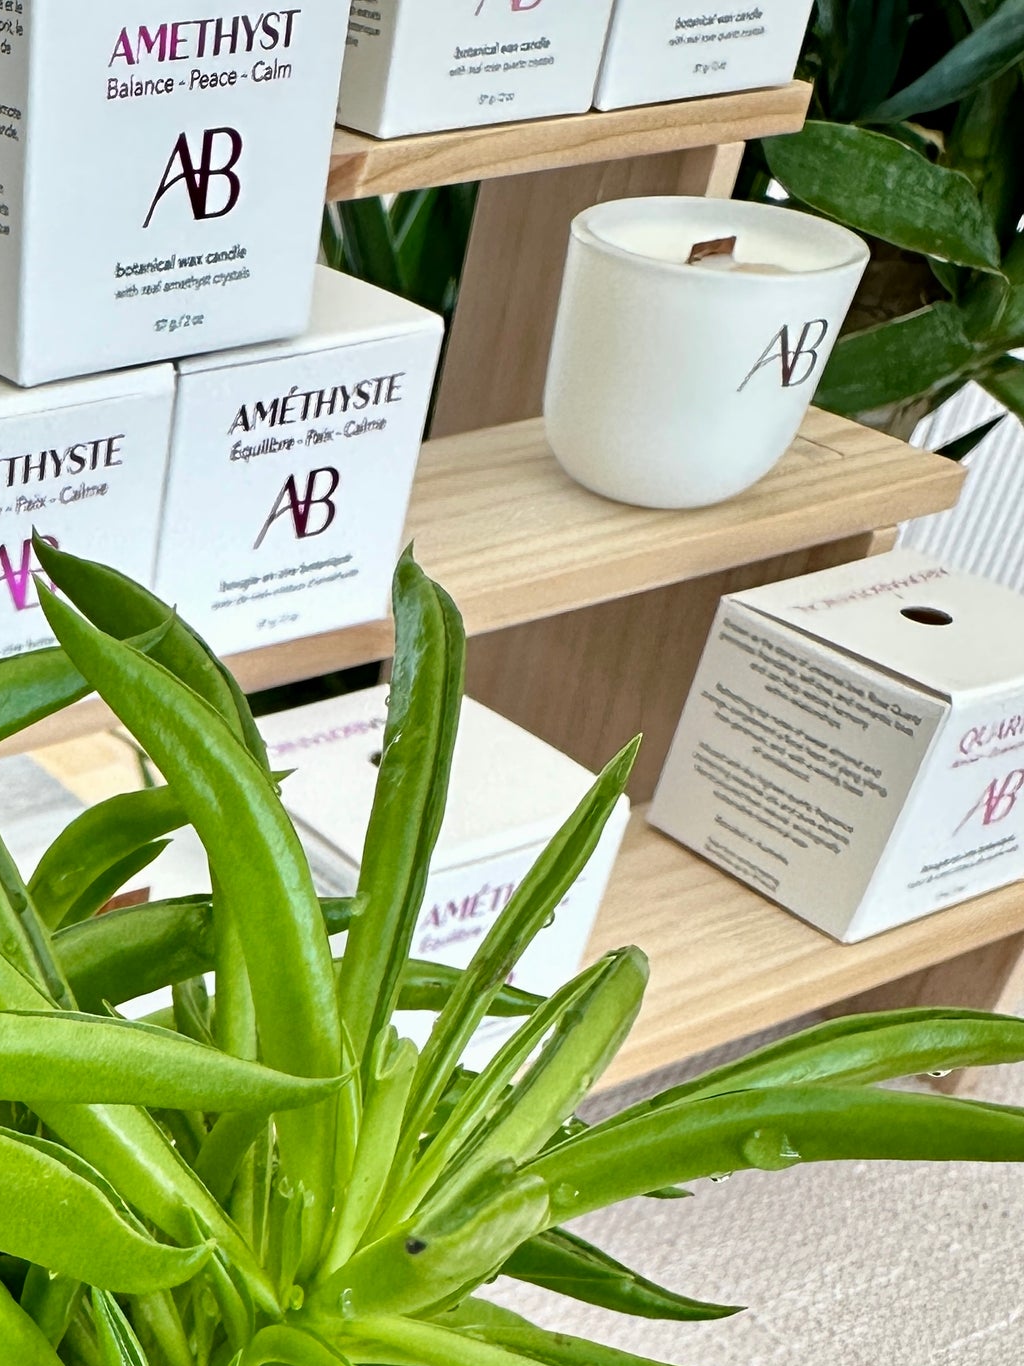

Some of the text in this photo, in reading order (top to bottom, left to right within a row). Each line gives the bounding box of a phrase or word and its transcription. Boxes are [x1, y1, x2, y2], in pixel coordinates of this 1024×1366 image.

[108, 9, 301, 67] AMETHYST
[107, 75, 174, 99] Balance
[189, 69, 237, 90] Peace
[251, 58, 292, 83] Calm
[142, 127, 243, 229] AB
[115, 244, 247, 278] botanical wax candle
[736, 318, 829, 393] AB
[227, 371, 406, 435] AMÉTHYSTE
[253, 466, 340, 550] AB
